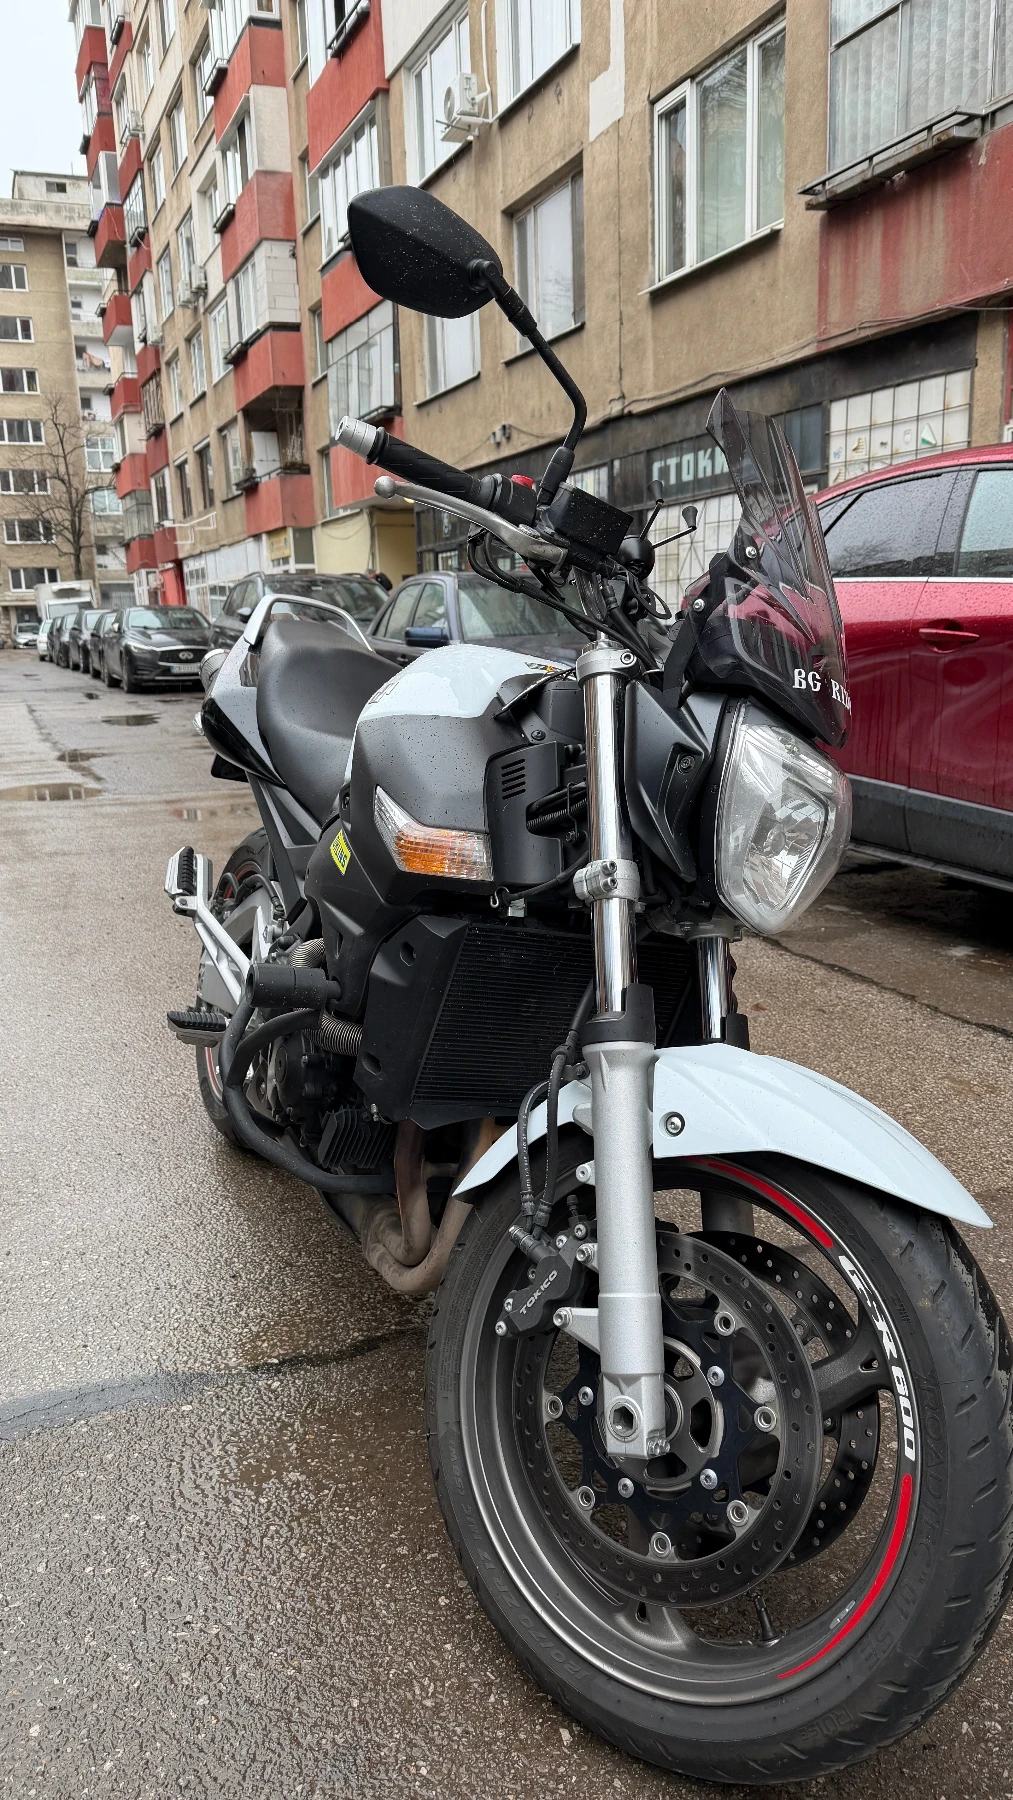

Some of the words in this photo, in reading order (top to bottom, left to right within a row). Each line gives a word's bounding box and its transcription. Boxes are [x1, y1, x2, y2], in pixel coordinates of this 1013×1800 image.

[793, 668, 821, 692] BG
[519, 1269, 558, 1315] TOKICO
[891, 1365, 916, 1462] 600
